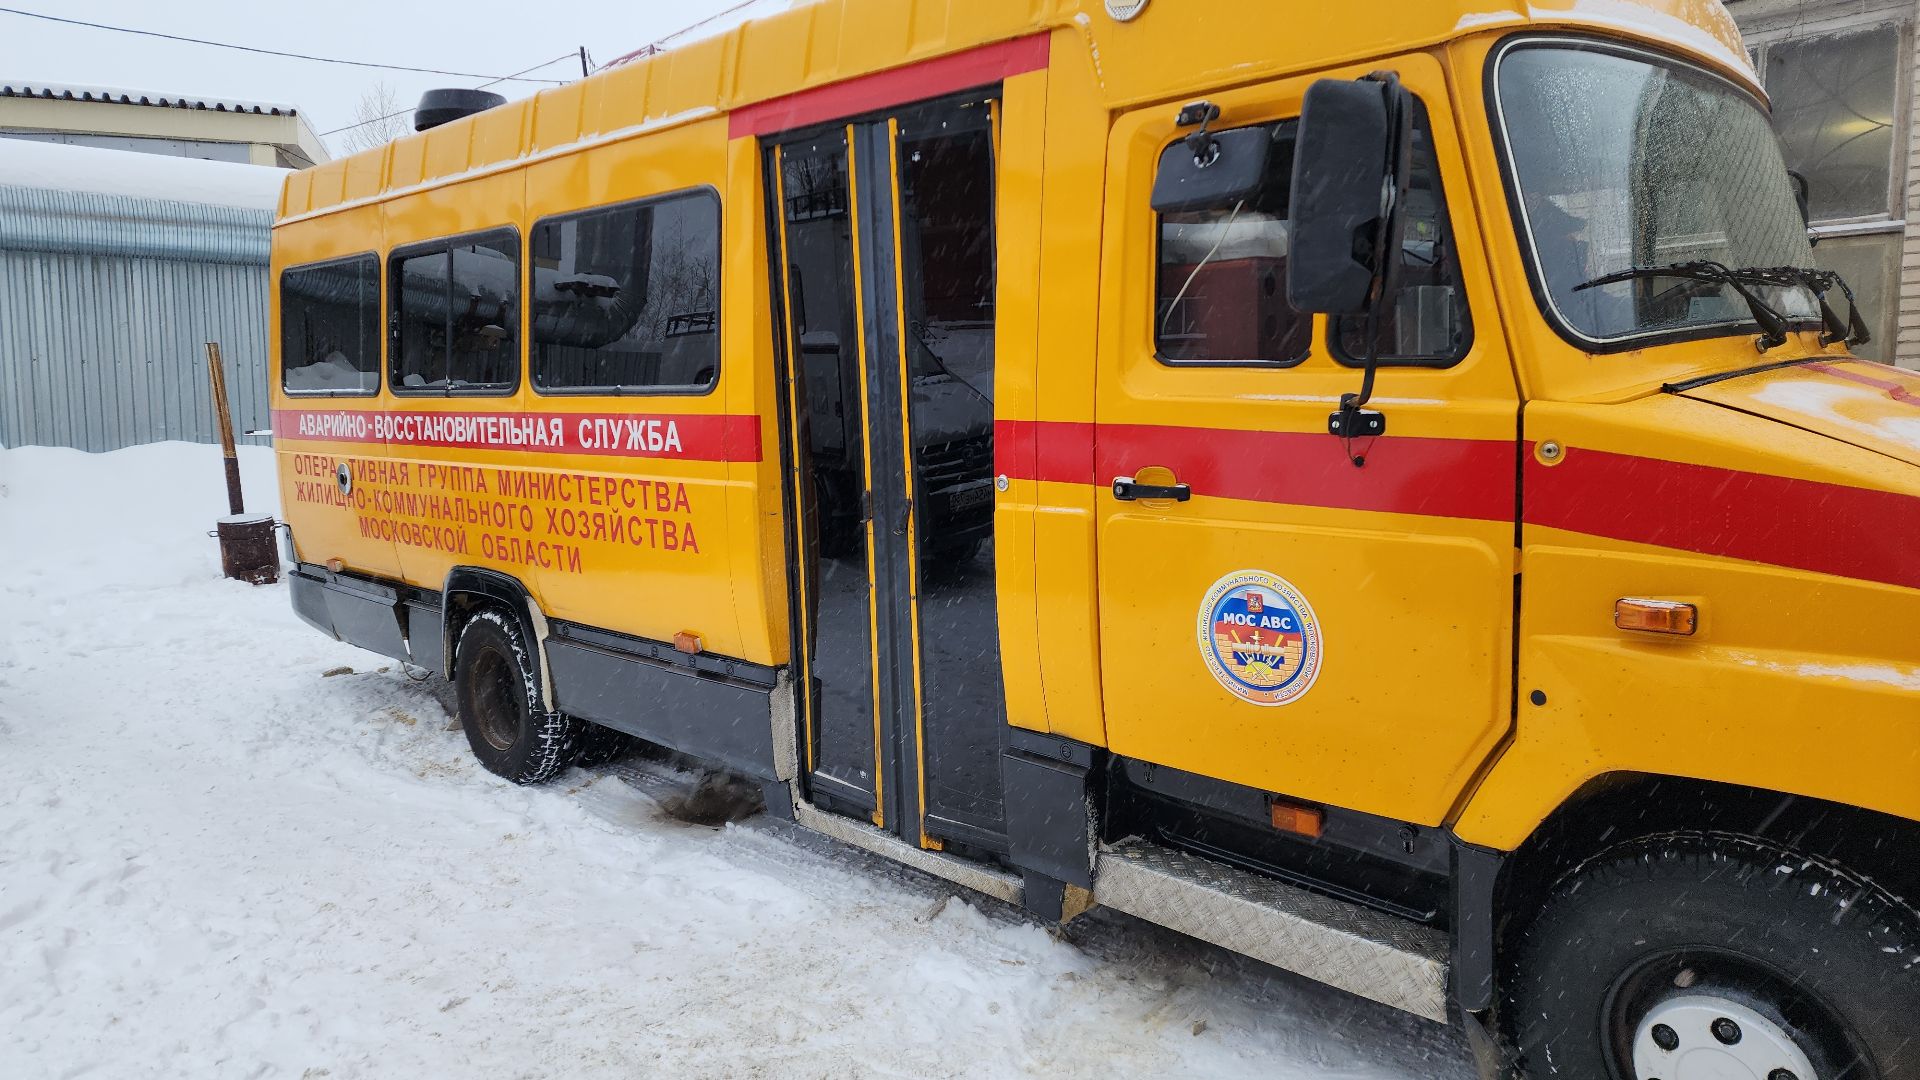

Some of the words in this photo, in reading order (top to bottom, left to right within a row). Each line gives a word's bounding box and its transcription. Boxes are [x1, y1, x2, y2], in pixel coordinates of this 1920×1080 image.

[298, 410, 565, 448] АВАРИЙНО-ВОССТАНОВИТЕЛЬНАЯ
[577, 418, 683, 453] СЛУЖБА
[294, 454, 409, 486] ОПЕРАТИВНАЯ
[418, 464, 488, 494] ГРУППА
[497, 471, 693, 515] МИНИСТЕРСТВА
[358, 515, 469, 555] МОСКОВСКОЙ
[481, 533, 583, 575] ОБЛАСТИ
[547, 508, 700, 555] ХОЗЯЙСТВА
[1223, 611, 1257, 627] МОС
[1259, 615, 1292, 630] АВС
